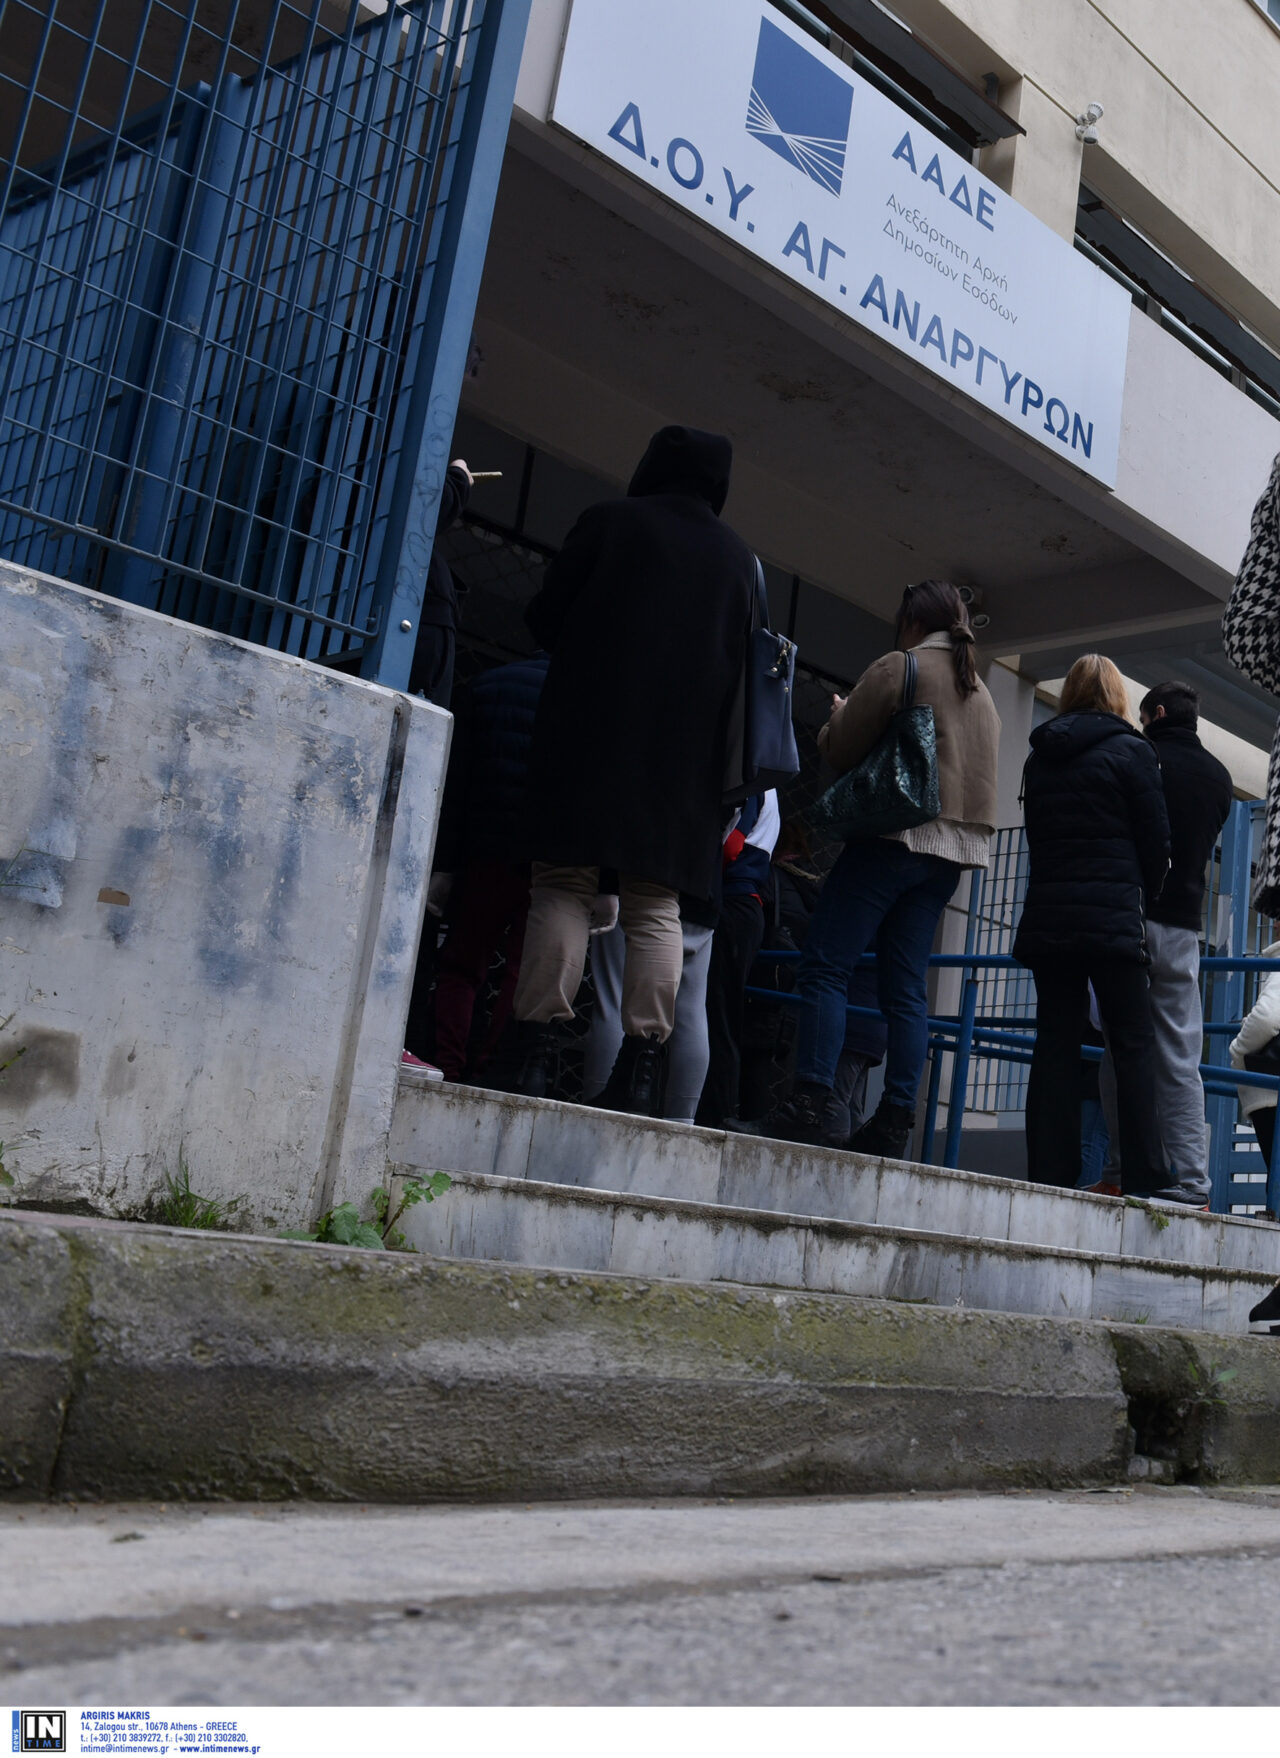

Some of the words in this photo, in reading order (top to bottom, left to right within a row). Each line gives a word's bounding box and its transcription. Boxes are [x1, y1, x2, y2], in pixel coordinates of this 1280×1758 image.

[892, 131, 996, 232] ΑΑΔΕ
[607, 102, 755, 233] Δ.Ο.Υ.
[782, 221, 847, 294] ΑΓ.
[859, 273, 1094, 458] ΑΝΑΡΓΥΡΩΝ
[883, 219, 958, 281] Δημοσίων
[963, 273, 1018, 324] Εσόδων
[886, 194, 968, 264] Ανεξάρτητη
[973, 256, 1008, 292] Αρχή
